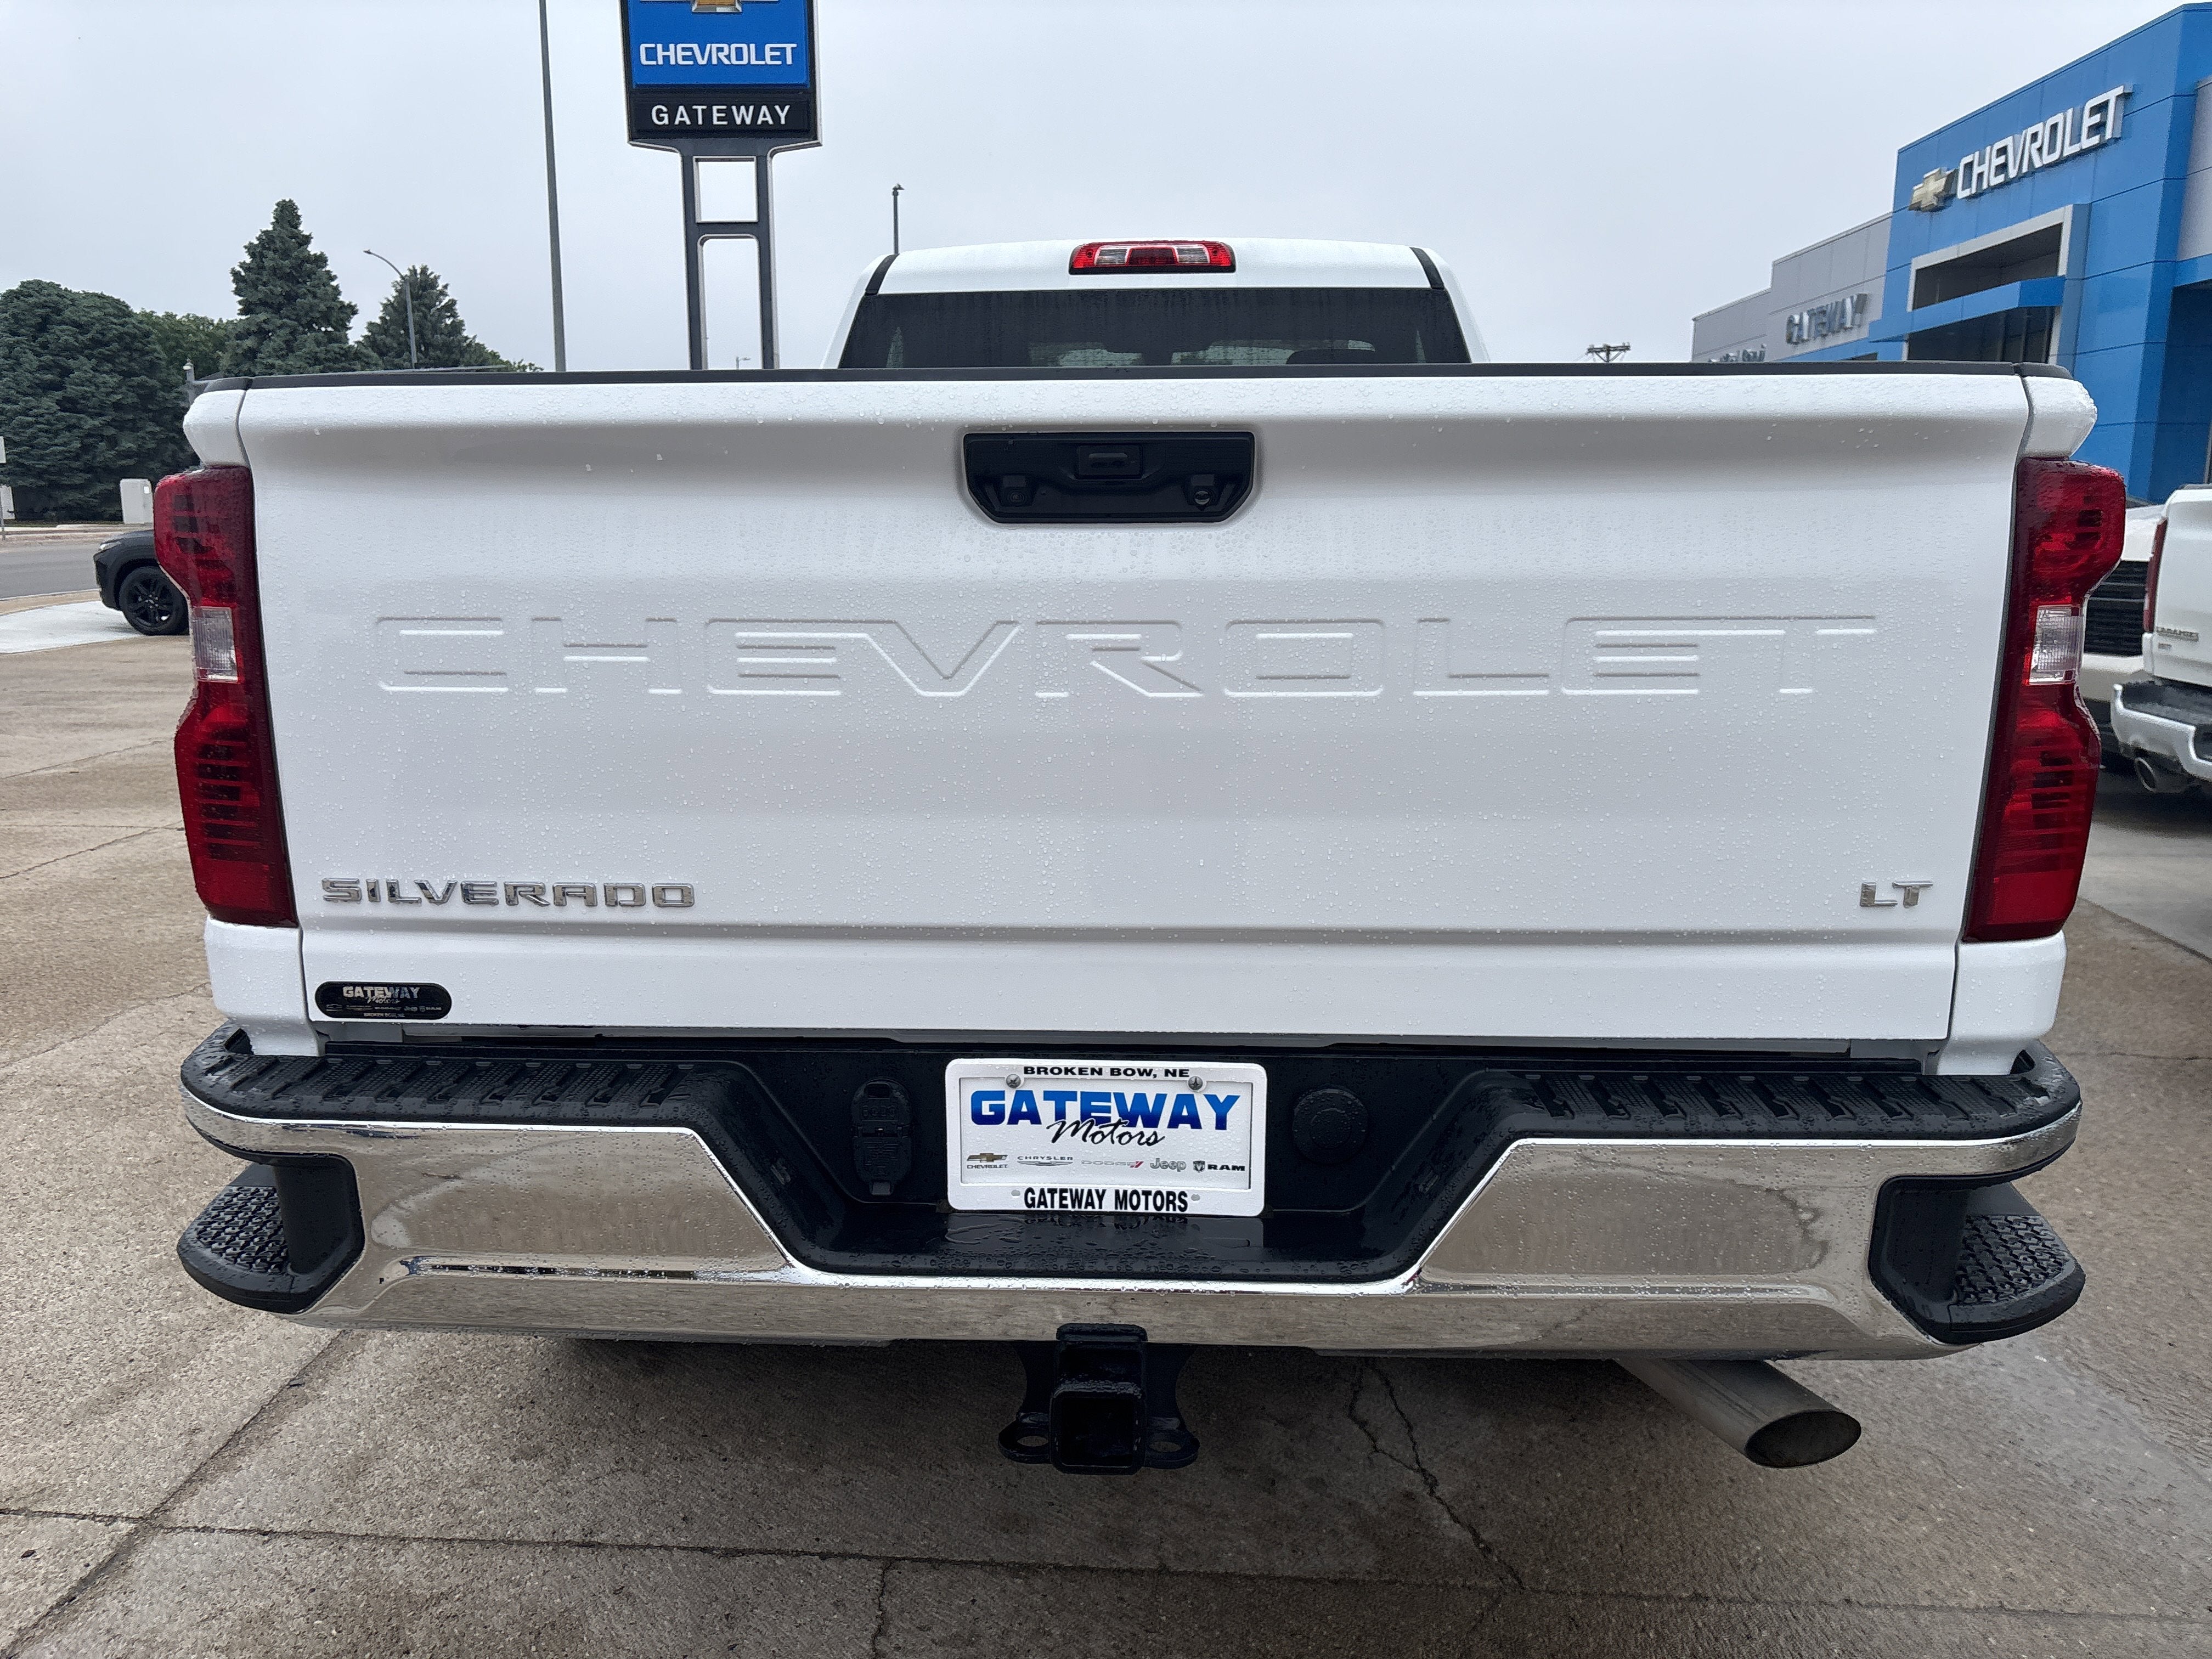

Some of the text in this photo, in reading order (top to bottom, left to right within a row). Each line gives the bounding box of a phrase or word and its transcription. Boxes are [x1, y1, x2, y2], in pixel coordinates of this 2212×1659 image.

[639, 43, 797, 65] CHEVROLET
[651, 104, 791, 126] GATEWAY
[1956, 85, 2126, 200] CHEVROLET
[1786, 293, 1869, 345] GATEWAY
[375, 616, 1877, 698] CHEVROLET
[321, 877, 695, 907] SILVERADO
[1860, 881, 1933, 909] LT
[342, 986, 421, 998] GATEWAY
[1024, 1066, 1190, 1079] BROKEN BOW, NE
[970, 1090, 1241, 1131] GATEWAY
[1046, 1118, 1166, 1147] Motors
[1149, 1158, 1187, 1172] Jeep
[1207, 1163, 1245, 1171] RAM
[1024, 1188, 1188, 1212] GATEWAY MOTORS
